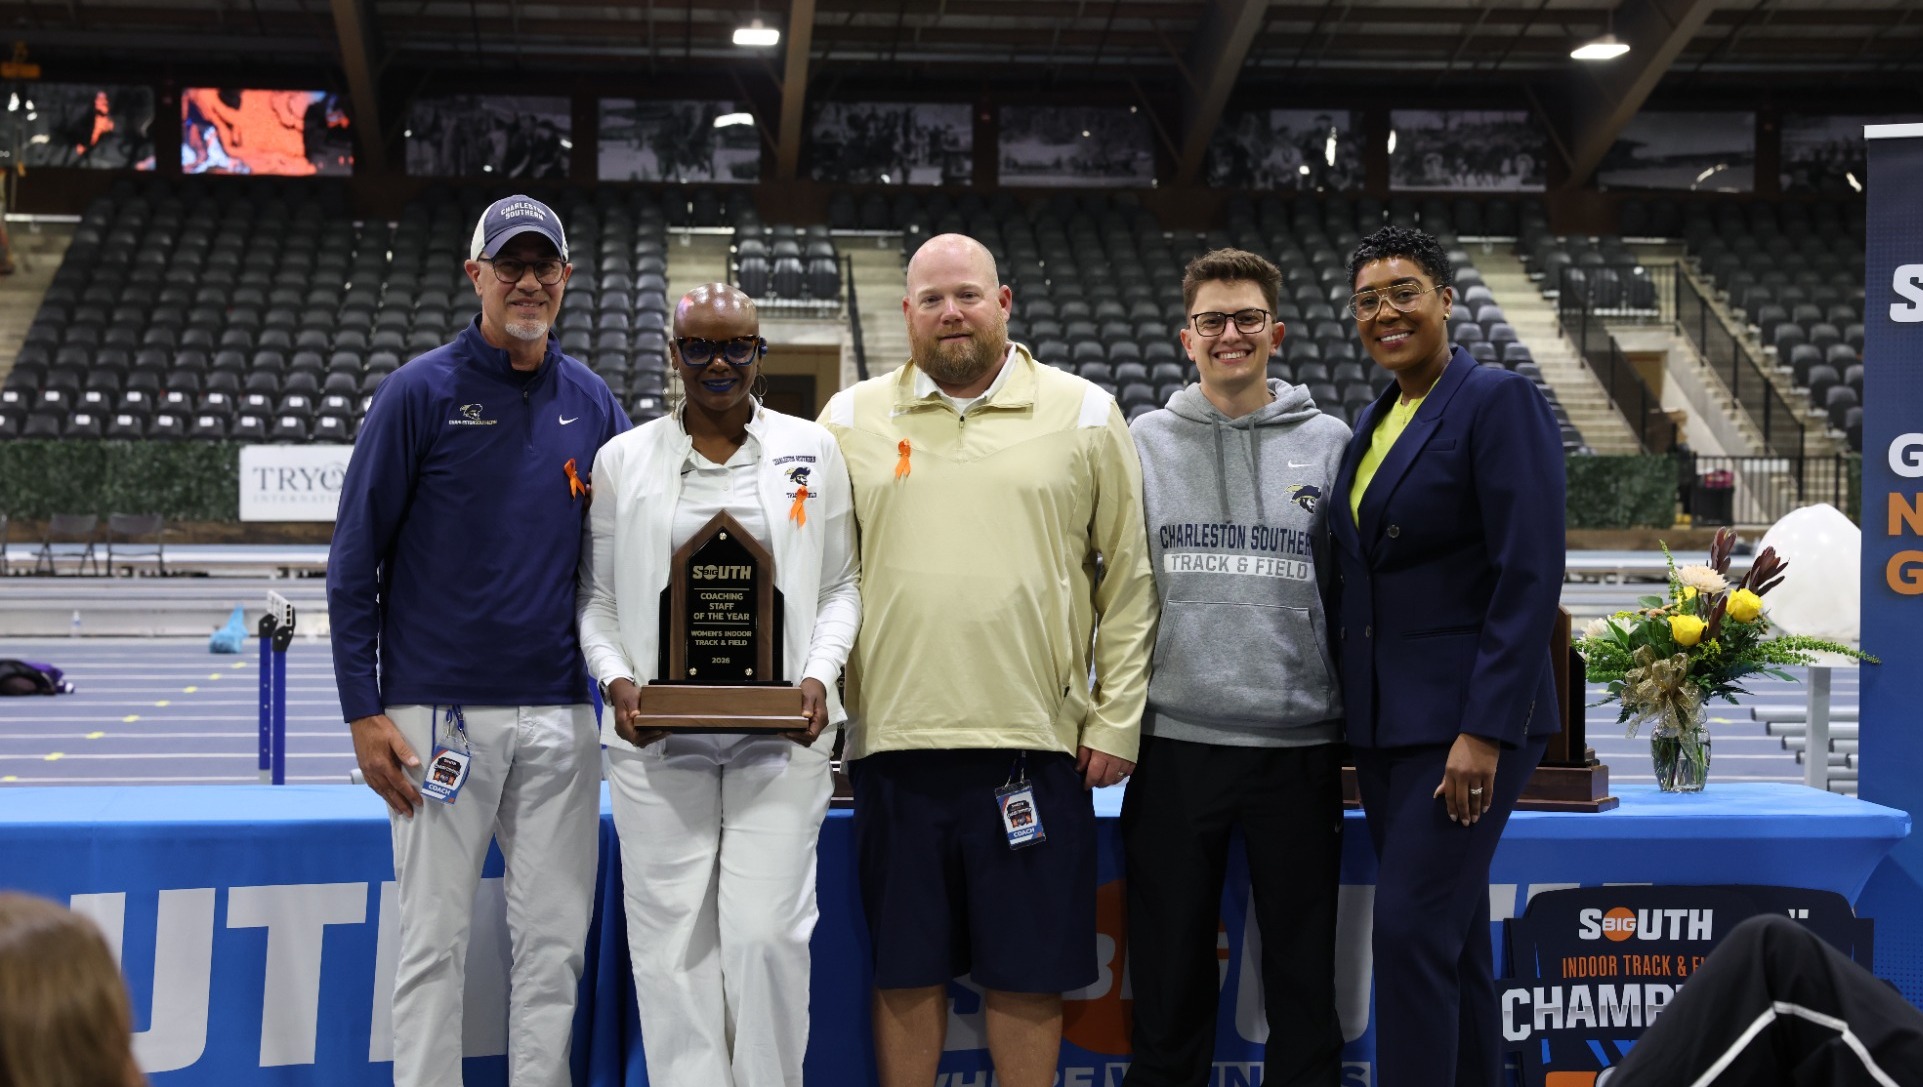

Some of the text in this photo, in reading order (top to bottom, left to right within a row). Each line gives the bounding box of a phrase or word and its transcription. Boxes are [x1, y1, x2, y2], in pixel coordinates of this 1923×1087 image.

[501, 202, 546, 216] CHARLESTON
[506, 209, 544, 220] SOUTHERN
[1160, 524, 1246, 549] CHARLESTON
[1171, 554, 1308, 580] TRACK & FIELD
[709, 602, 735, 610] STAFF
[693, 612, 705, 620] OF
[708, 612, 724, 620] THE
[429, 784, 451, 795] COACH
[1013, 828, 1035, 837] COACH
[1603, 917, 1637, 932] BIG
[1562, 955, 1618, 979] INDOOR
[1623, 954, 1671, 977] TRACK
[1677, 955, 1688, 977] &
[1502, 983, 1684, 1042] CHAMP
